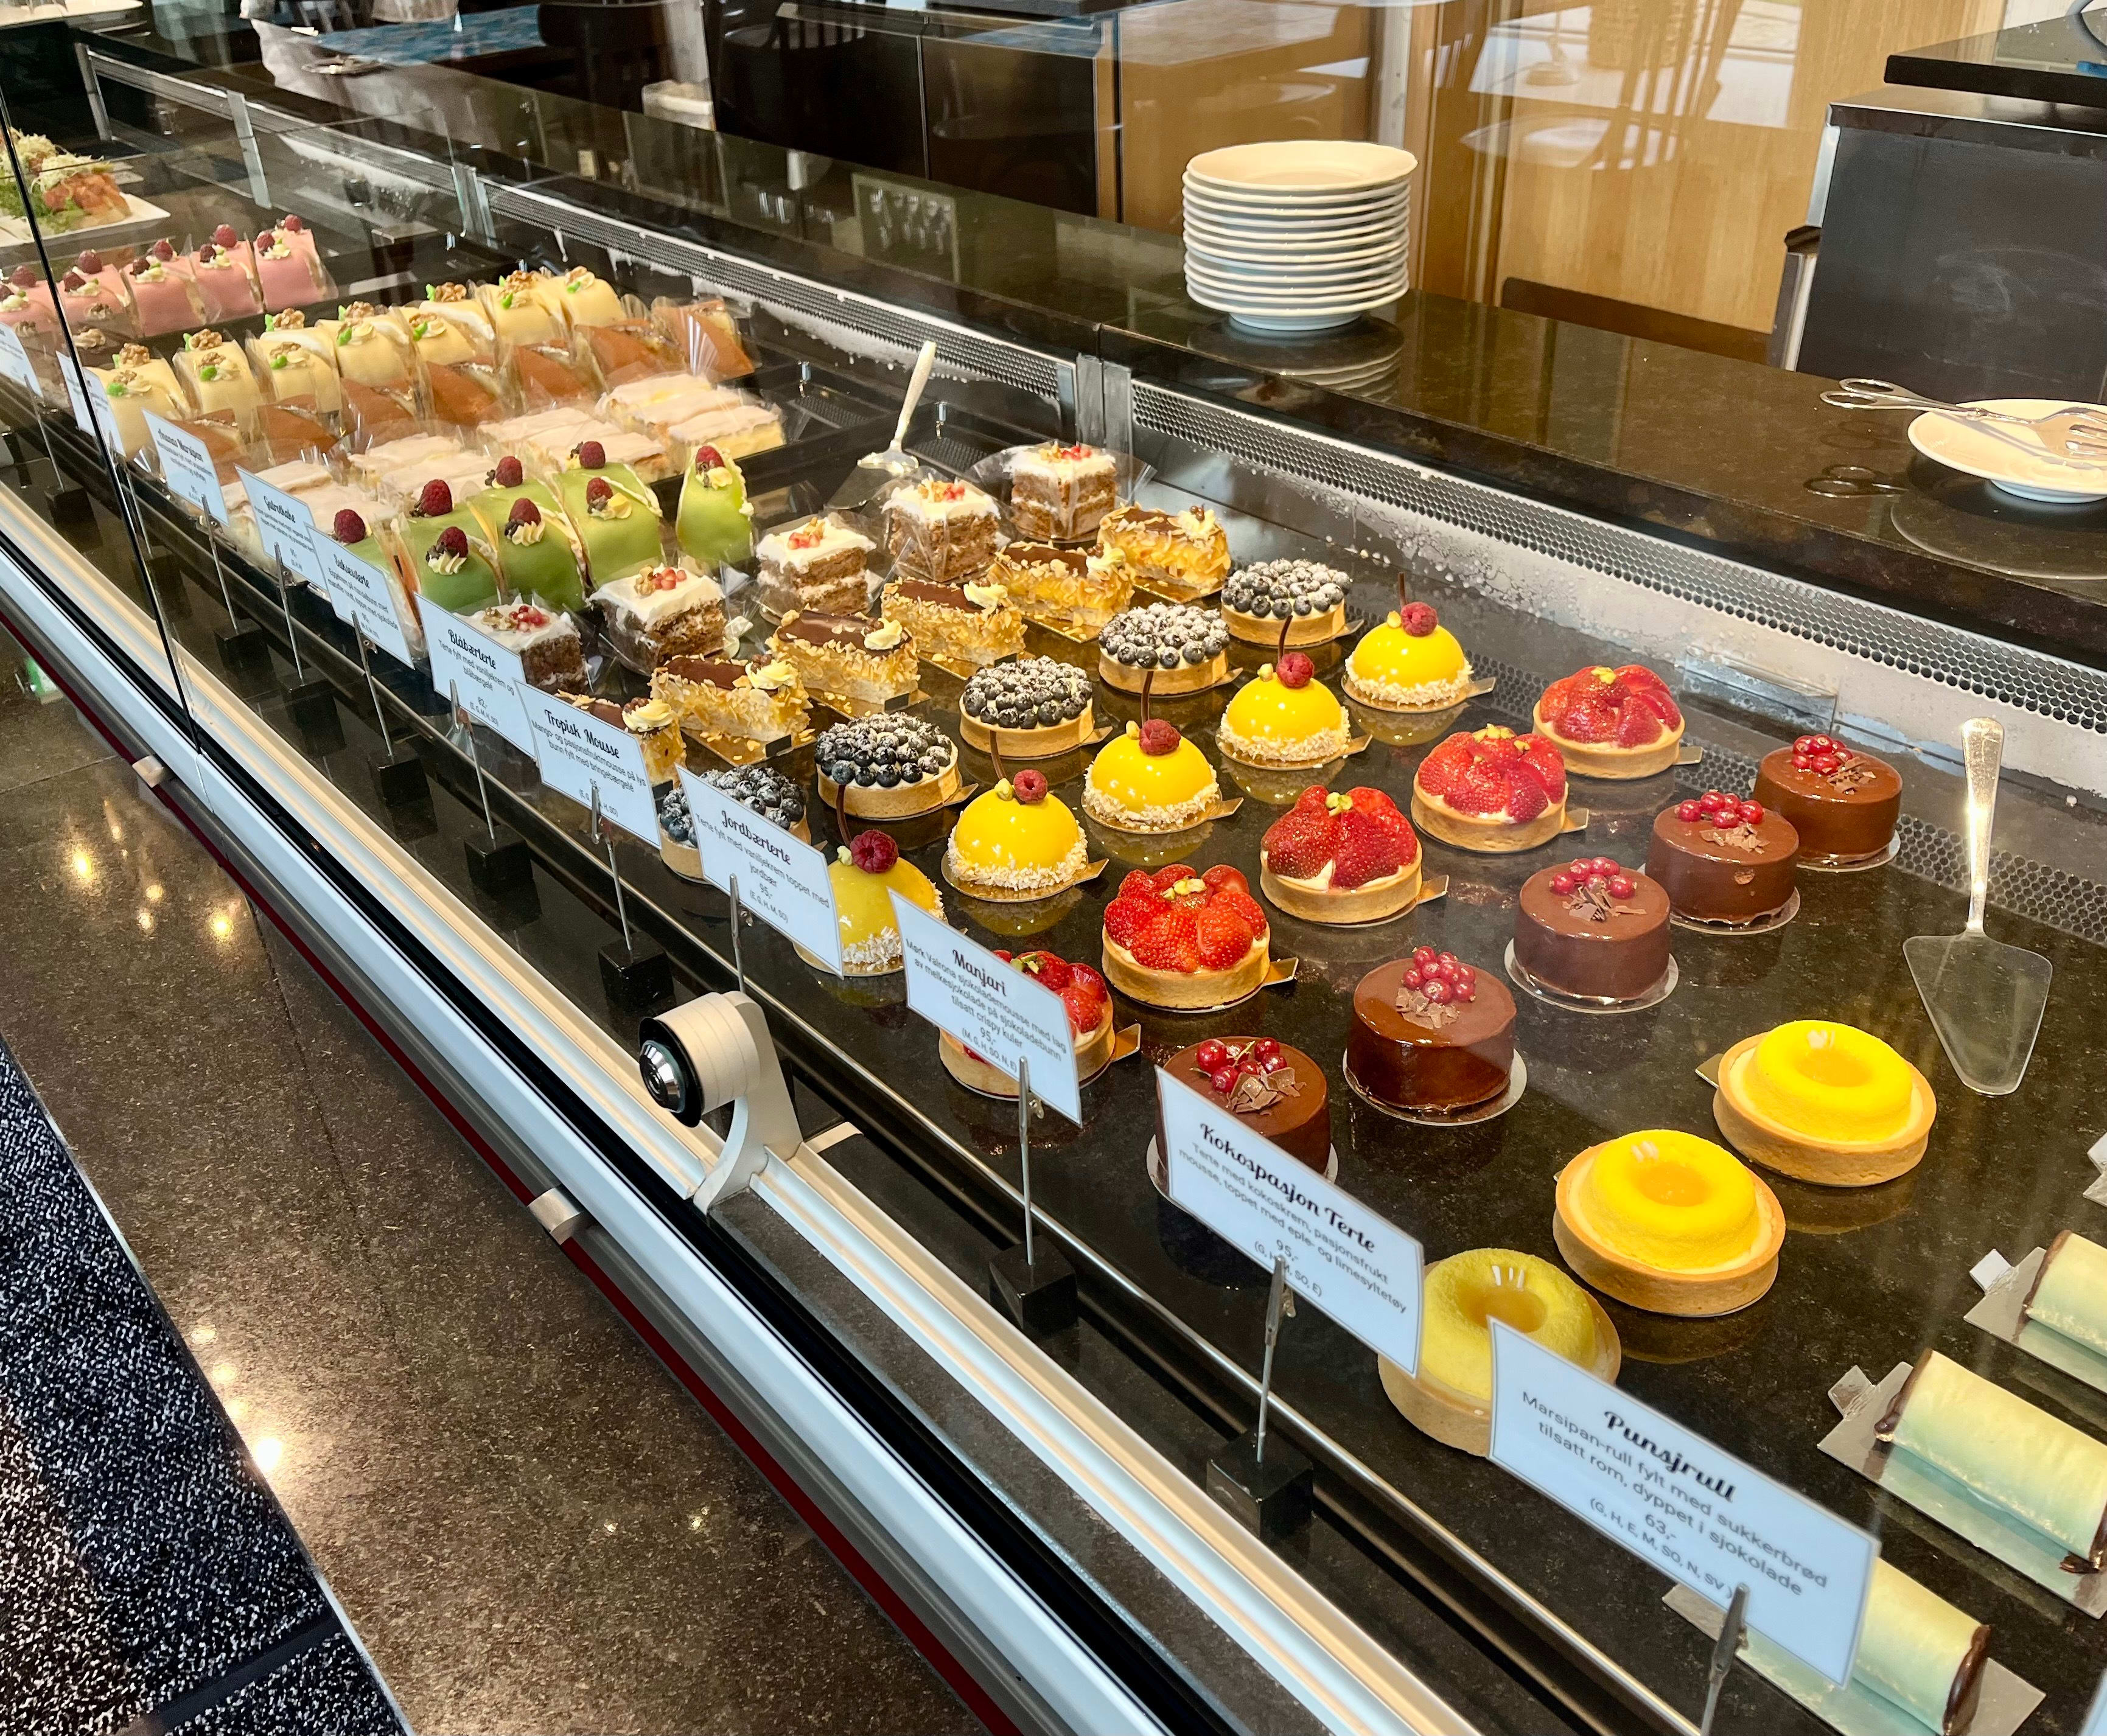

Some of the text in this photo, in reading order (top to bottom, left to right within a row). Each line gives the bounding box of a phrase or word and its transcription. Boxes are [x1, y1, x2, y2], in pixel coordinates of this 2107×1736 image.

[438, 640, 452, 654] Terte
[463, 657, 475, 668] med
[448, 629, 496, 669] Blåbærterte
[545, 709, 619, 758] Tropisk Mousse
[565, 748, 575, 760] fylt
[576, 755, 589, 767] med
[696, 814, 714, 832] Terte
[715, 826, 726, 840] fylt
[727, 836, 743, 851] med
[786, 874, 811, 896] toppet
[812, 892, 830, 908] med
[722, 810, 791, 865] Jordbærterte
[749, 862, 777, 887] jordbær
[952, 950, 1006, 997] Manjari
[951, 995, 1022, 1048] tilsatt crispy kuler
[988, 1006, 998, 1019] på
[1000, 1015, 1061, 1061] sjokoladebunn
[1032, 1023, 1050, 1041] med
[1052, 1035, 1066, 1054] lag
[1193, 1143, 1219, 1168] Terte
[1222, 1165, 1245, 1186] med
[1315, 1229, 1388, 1284] pasjonsfrukt
[1201, 1124, 1374, 1252] Kokospasjon Terte
[1225, 1180, 1258, 1210] toppet
[1261, 1207, 1284, 1228] med
[1318, 1247, 1332, 1263] og
[1604, 1412, 1735, 1502] Punsjrull
[1523, 1392, 1827, 1588] Marsipan-rull fylt med sukkerbrød
[1539, 1422, 1584, 1459] tilsatt
[1590, 1455, 1627, 1487] rom,
[1634, 1483, 1693, 1527] dyppet
[1709, 1532, 1801, 1595] sjokolade
[1645, 1514, 1676, 1539] 63,-
